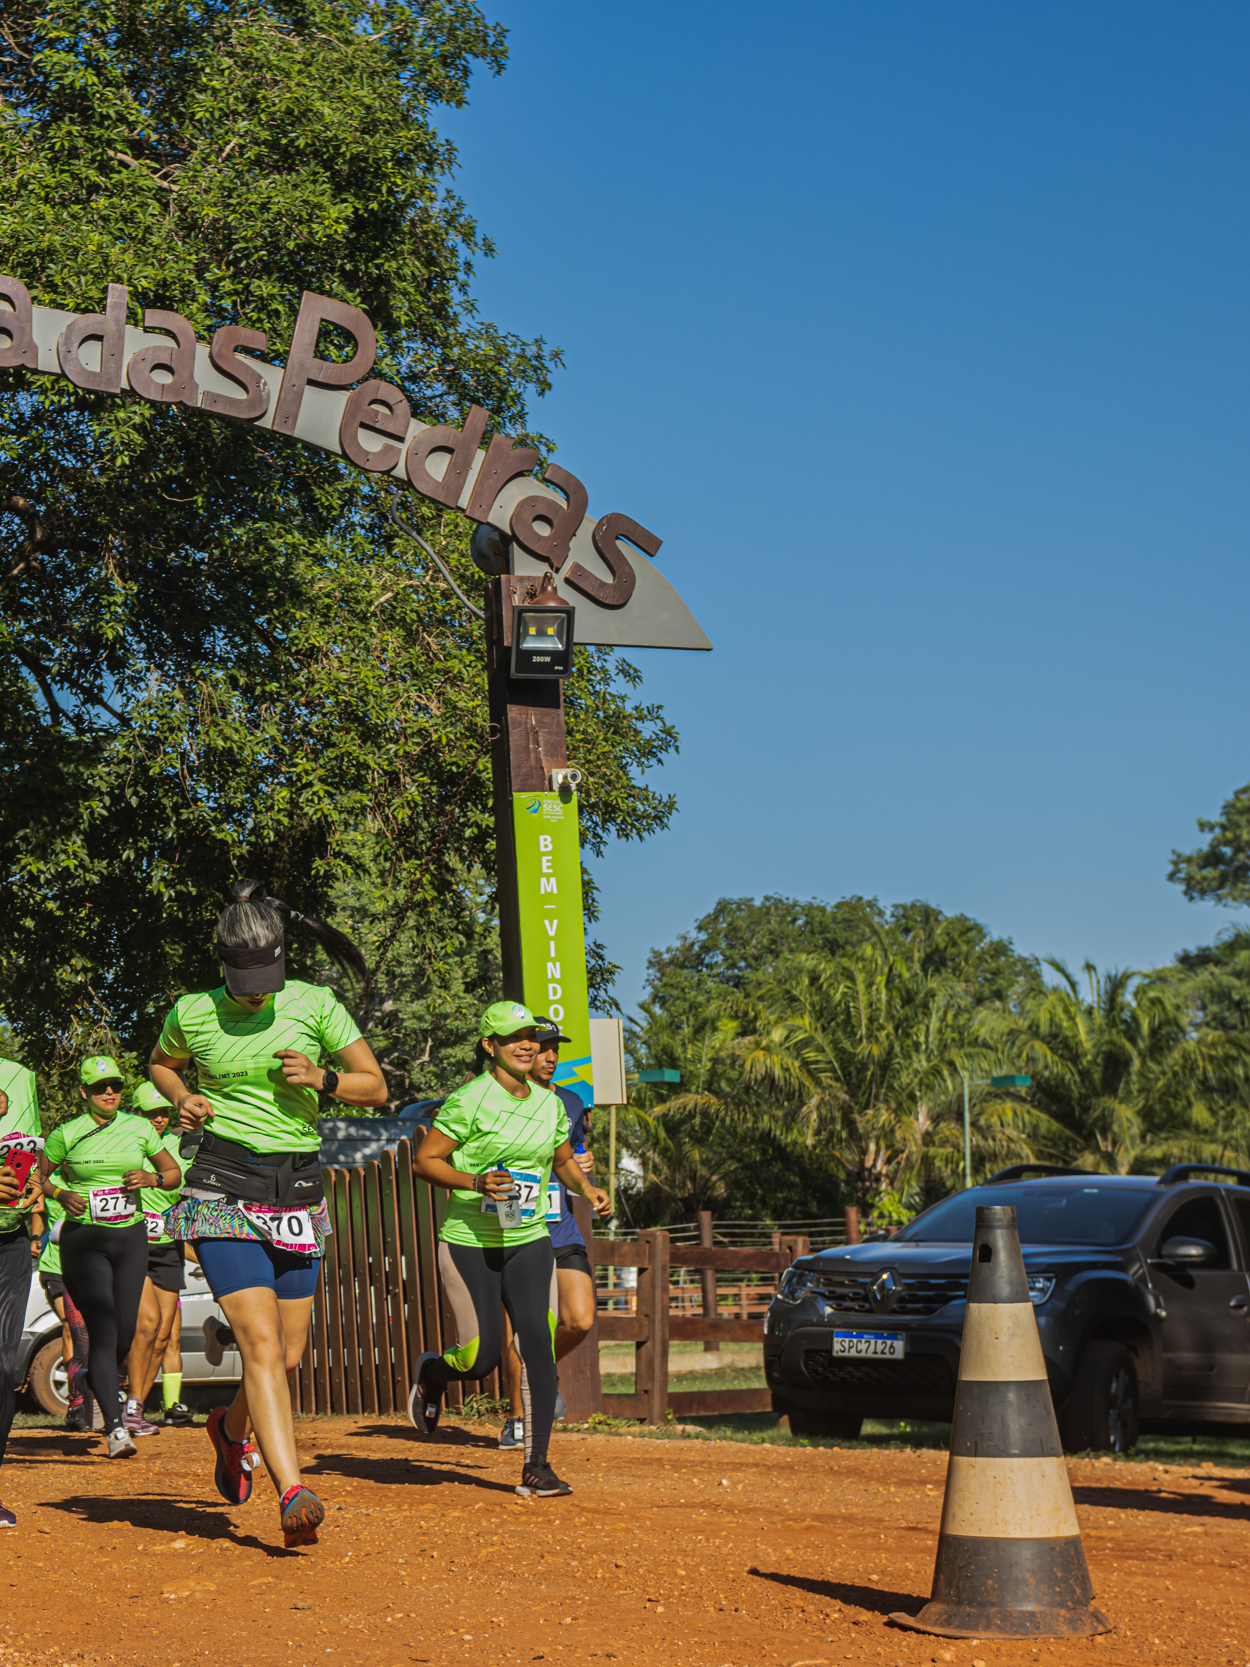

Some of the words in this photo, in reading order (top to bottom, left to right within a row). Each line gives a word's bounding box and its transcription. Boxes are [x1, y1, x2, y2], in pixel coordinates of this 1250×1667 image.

[56, 283, 272, 422] das
[272, 289, 664, 608] Pedras
[532, 655, 551, 663] 200W
[543, 804, 563, 812] SESC
[231, 1070, 249, 1078] 2023
[99, 1195, 130, 1213] 277
[256, 1215, 304, 1237] 370
[839, 1339, 896, 1356] SPC7I26
